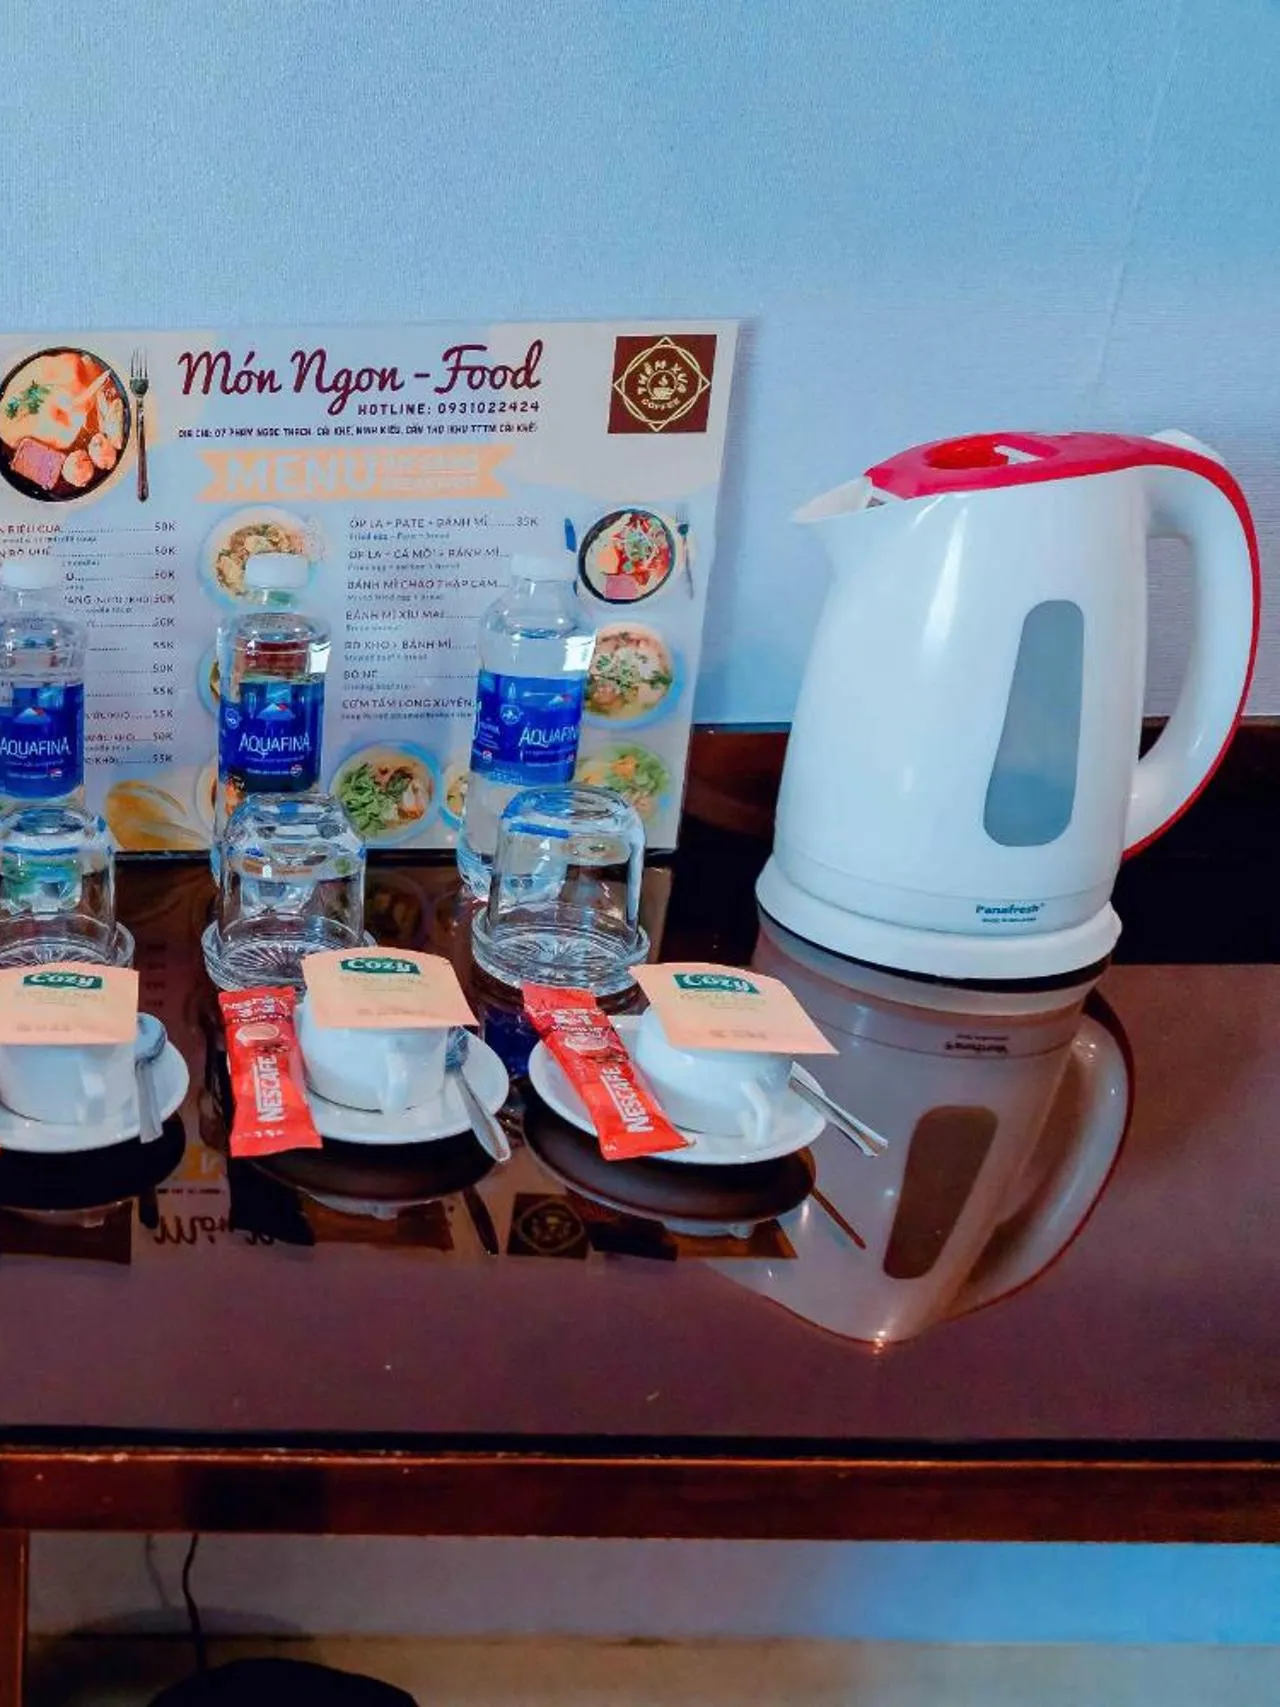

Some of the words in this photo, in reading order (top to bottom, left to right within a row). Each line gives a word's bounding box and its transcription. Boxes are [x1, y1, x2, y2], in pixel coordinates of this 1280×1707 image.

[177, 350, 282, 395] Món
[290, 348, 405, 416] Ngon
[433, 339, 543, 394] Food
[357, 403, 432, 416] HOTLINE:
[437, 401, 541, 415] 0931022424
[227, 454, 378, 494] MENU
[153, 521, 177, 532] 50K
[0, 736, 72, 759] AQUAFINA
[238, 731, 313, 757] AQUAFINA
[347, 958, 412, 972] Cozy
[30, 973, 95, 987] Cozy
[682, 974, 751, 991] Cozy
